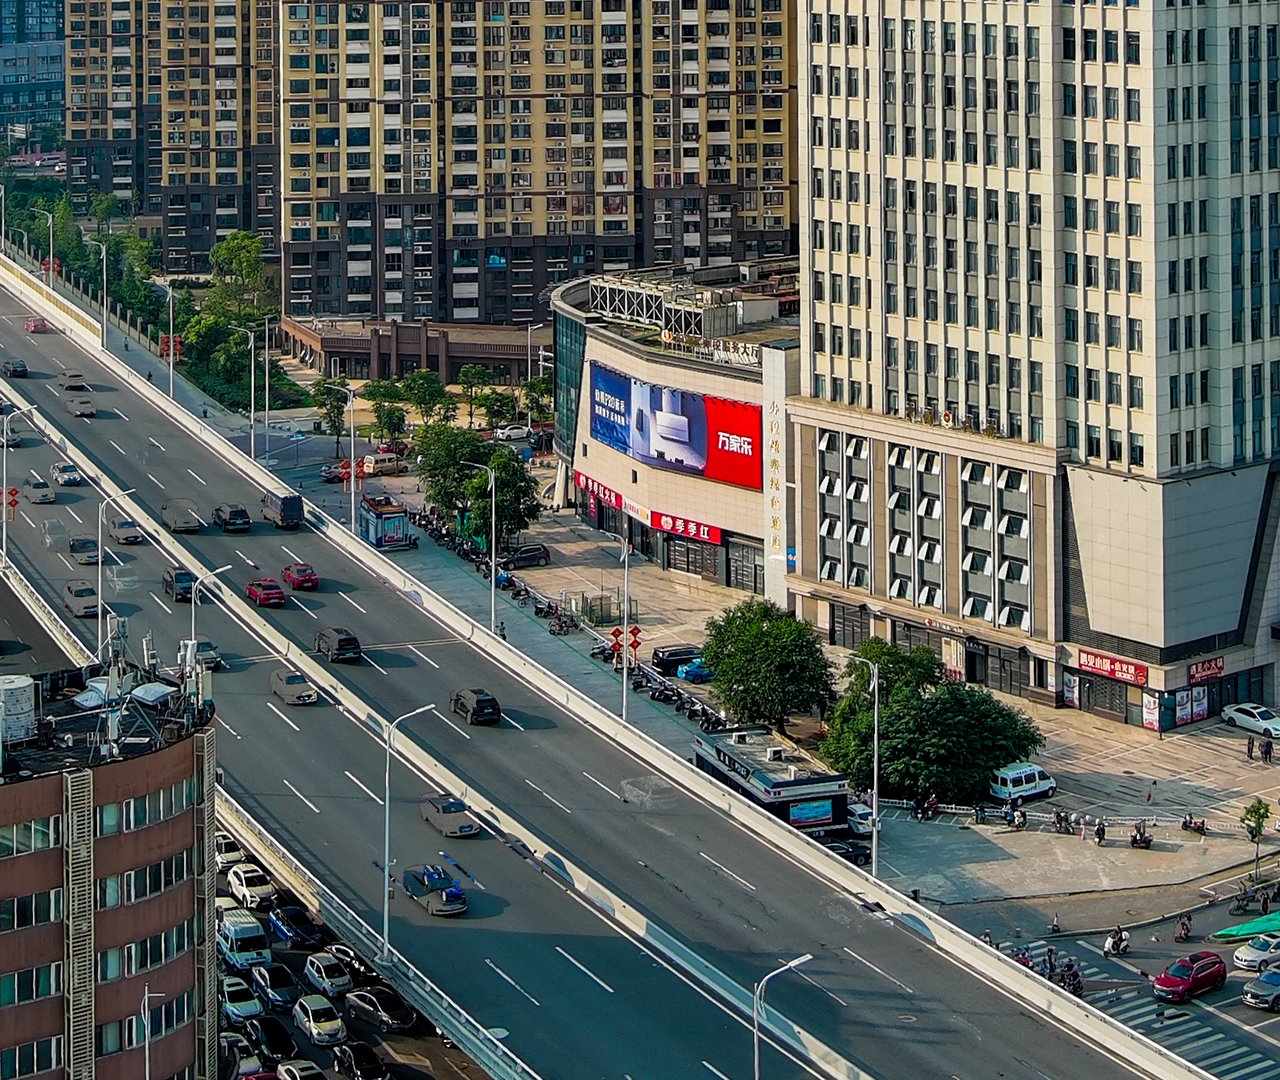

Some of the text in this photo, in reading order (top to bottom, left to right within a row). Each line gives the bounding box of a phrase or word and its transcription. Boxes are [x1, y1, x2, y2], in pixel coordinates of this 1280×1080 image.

[718, 431, 752, 456] 万家乐
[675, 518, 709, 540] 季季红
